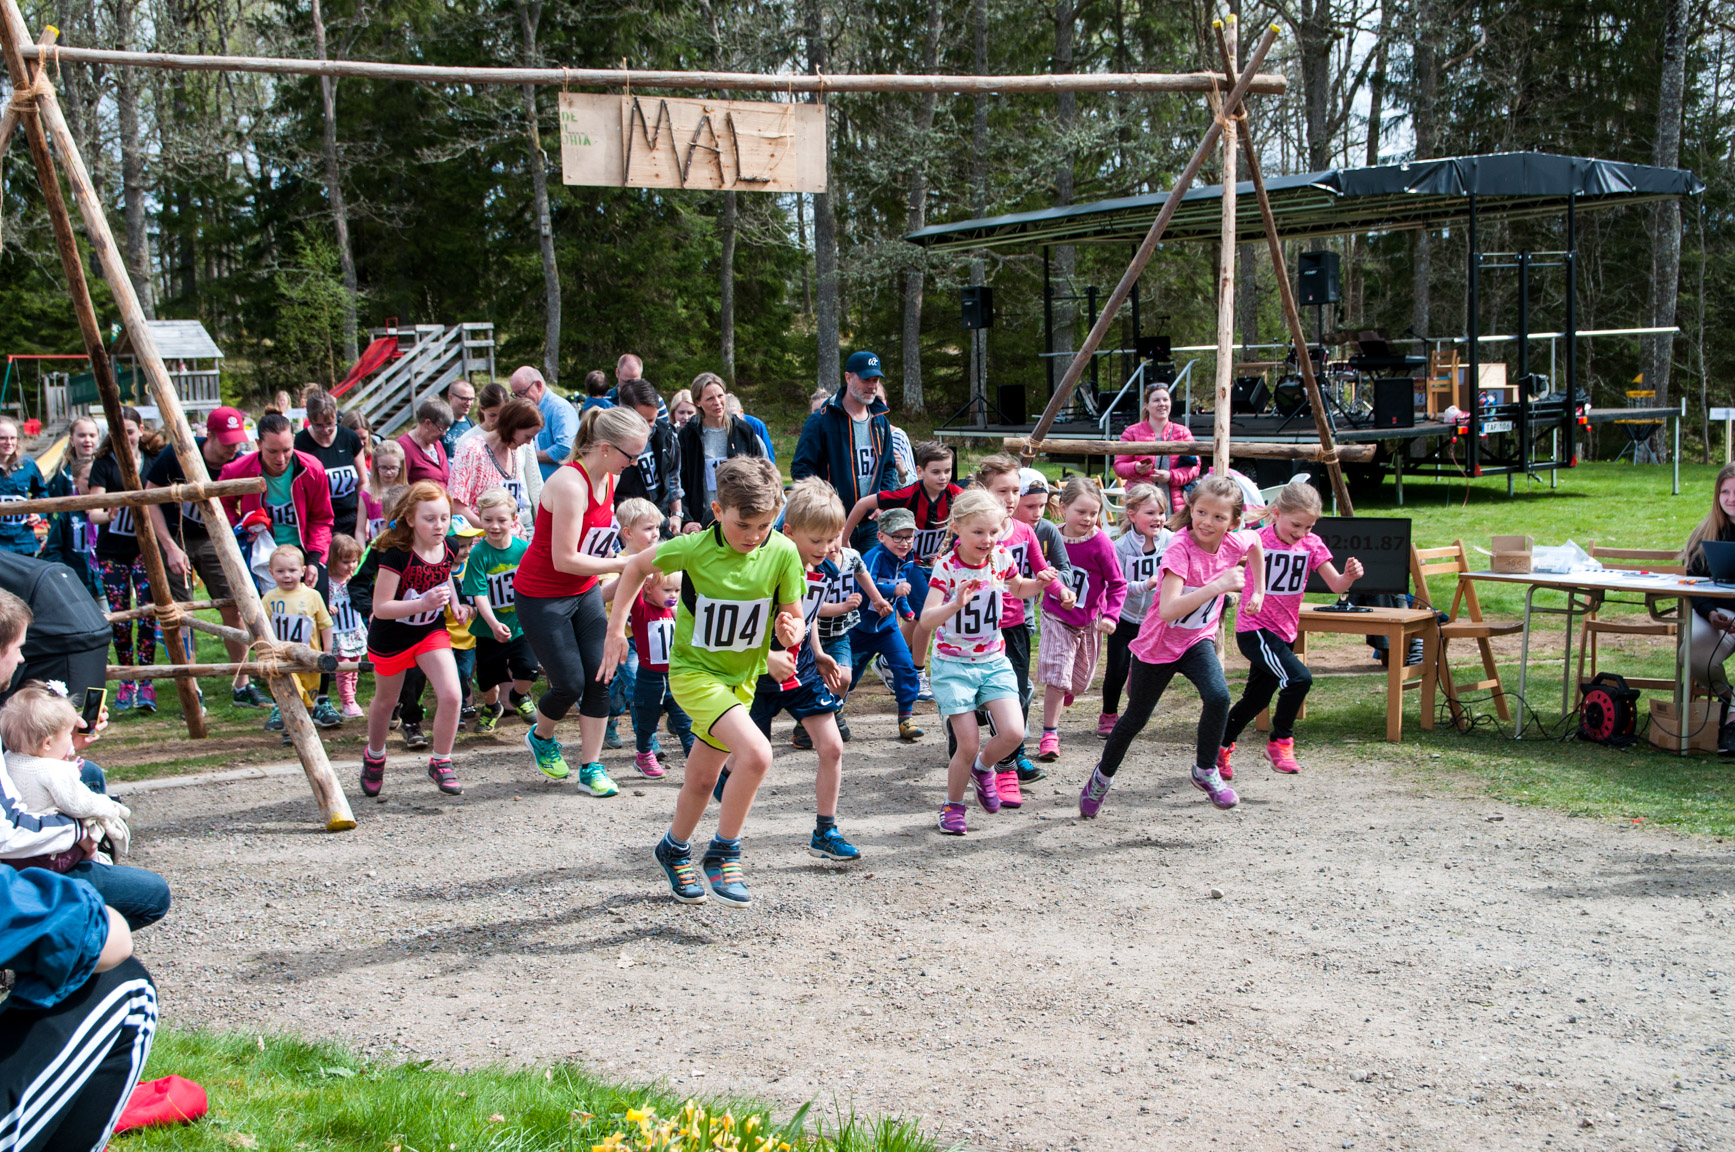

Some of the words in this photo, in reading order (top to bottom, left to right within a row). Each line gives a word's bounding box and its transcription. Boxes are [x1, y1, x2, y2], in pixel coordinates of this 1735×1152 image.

[1264, 552, 1307, 592] 128
[275, 615, 304, 643] 114
[703, 602, 761, 647] 104
[956, 590, 998, 634] 154
